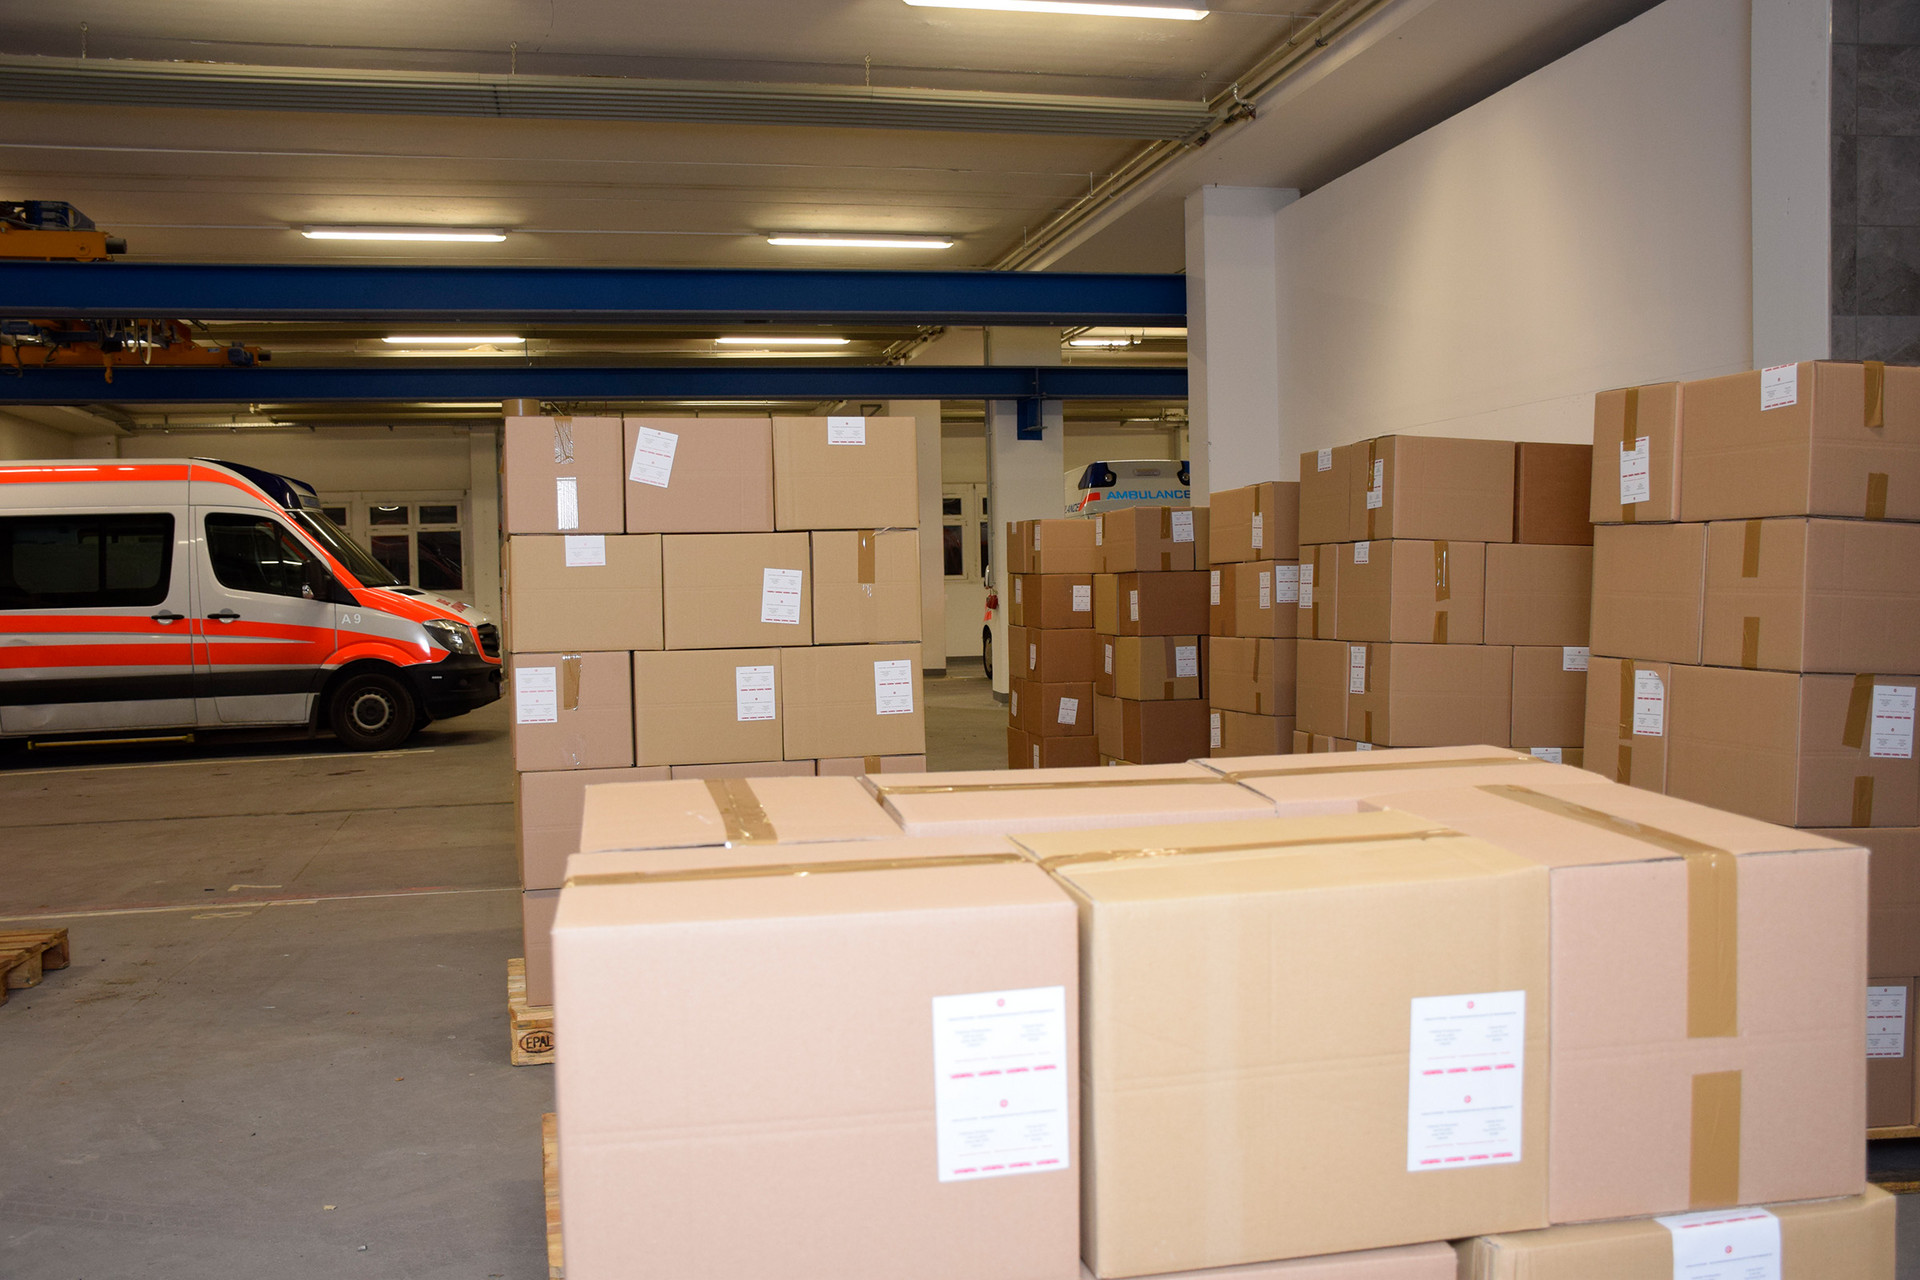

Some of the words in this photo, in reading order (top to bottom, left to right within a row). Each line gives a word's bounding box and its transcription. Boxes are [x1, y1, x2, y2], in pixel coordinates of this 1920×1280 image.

[1107, 490, 1190, 500] AMBULANCE
[341, 614, 352, 625] A
[354, 613, 362, 624] 9
[526, 1035, 553, 1049] EPAL
